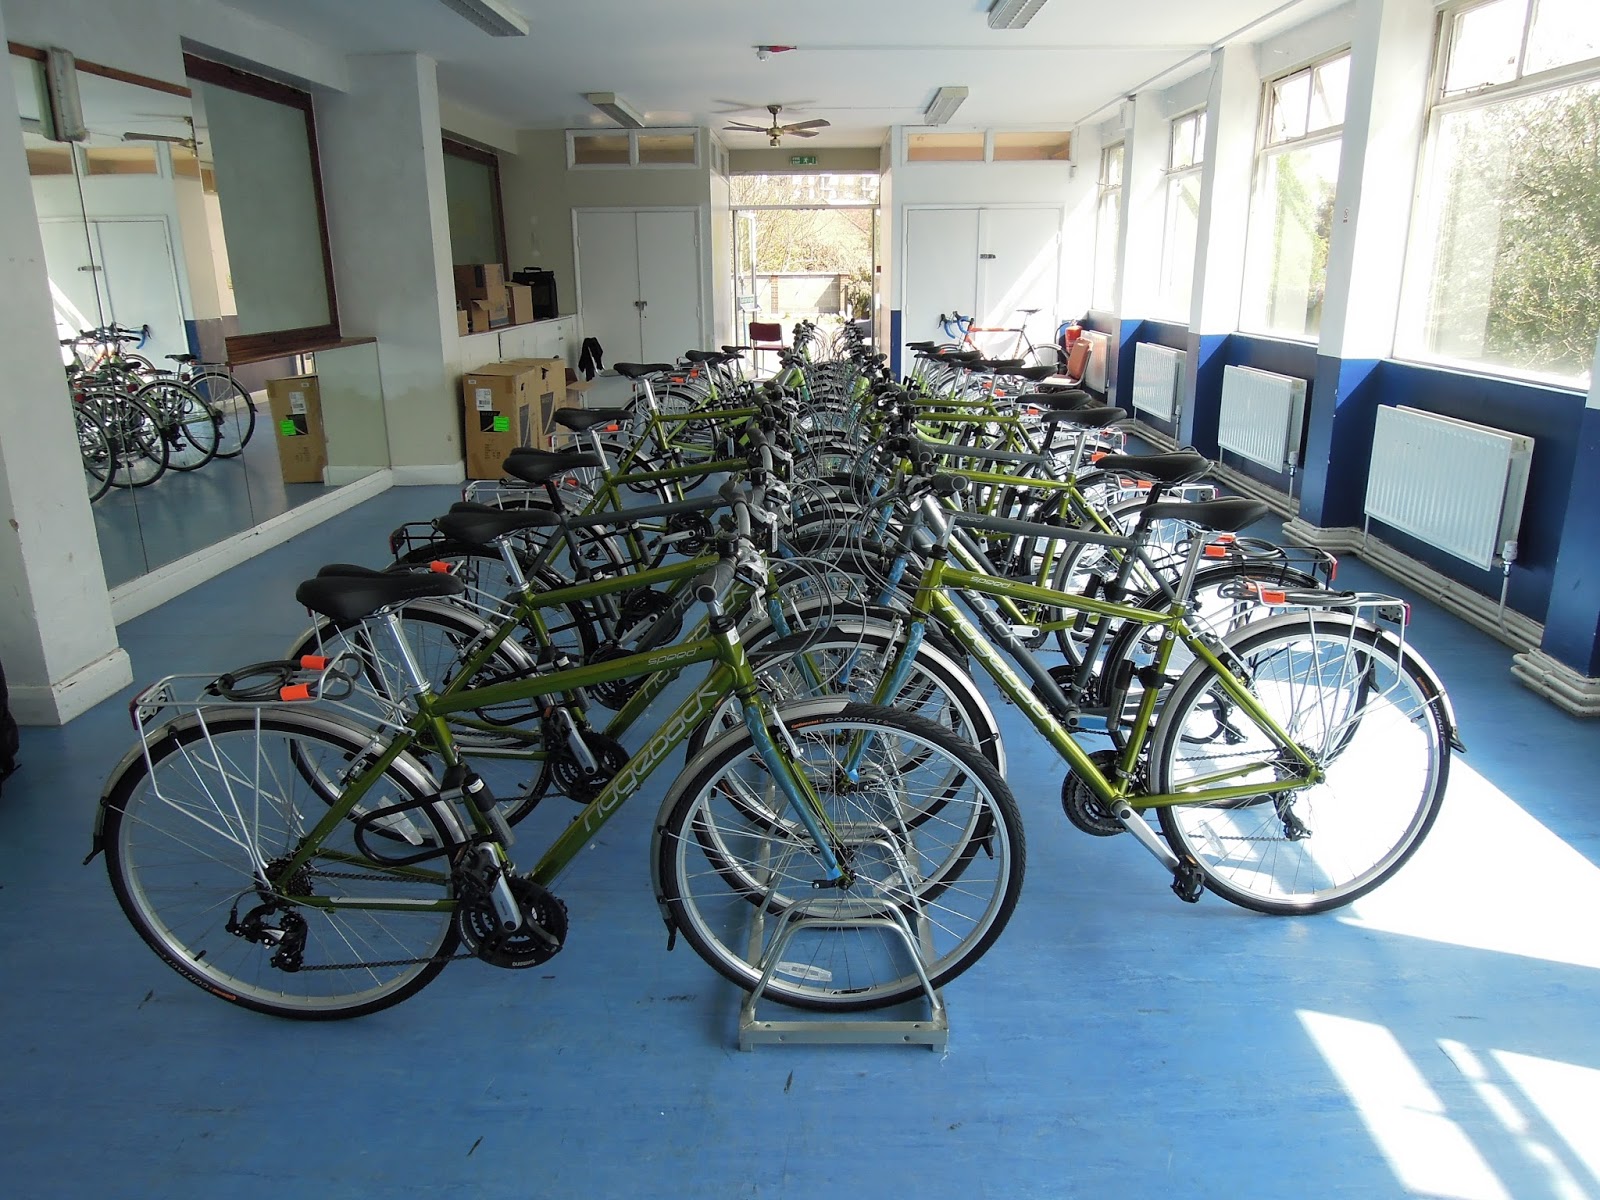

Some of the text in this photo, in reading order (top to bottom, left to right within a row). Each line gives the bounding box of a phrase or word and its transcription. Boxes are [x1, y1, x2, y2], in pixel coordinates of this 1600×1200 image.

[954, 515, 985, 523] peed
[971, 576, 1012, 589] speed
[1265, 576, 1300, 588] COTACT
[648, 648, 698, 666] speed
[942, 605, 1062, 733] ridgeback
[825, 716, 883, 724] CONTACT
[583, 679, 718, 833] ridgeback
